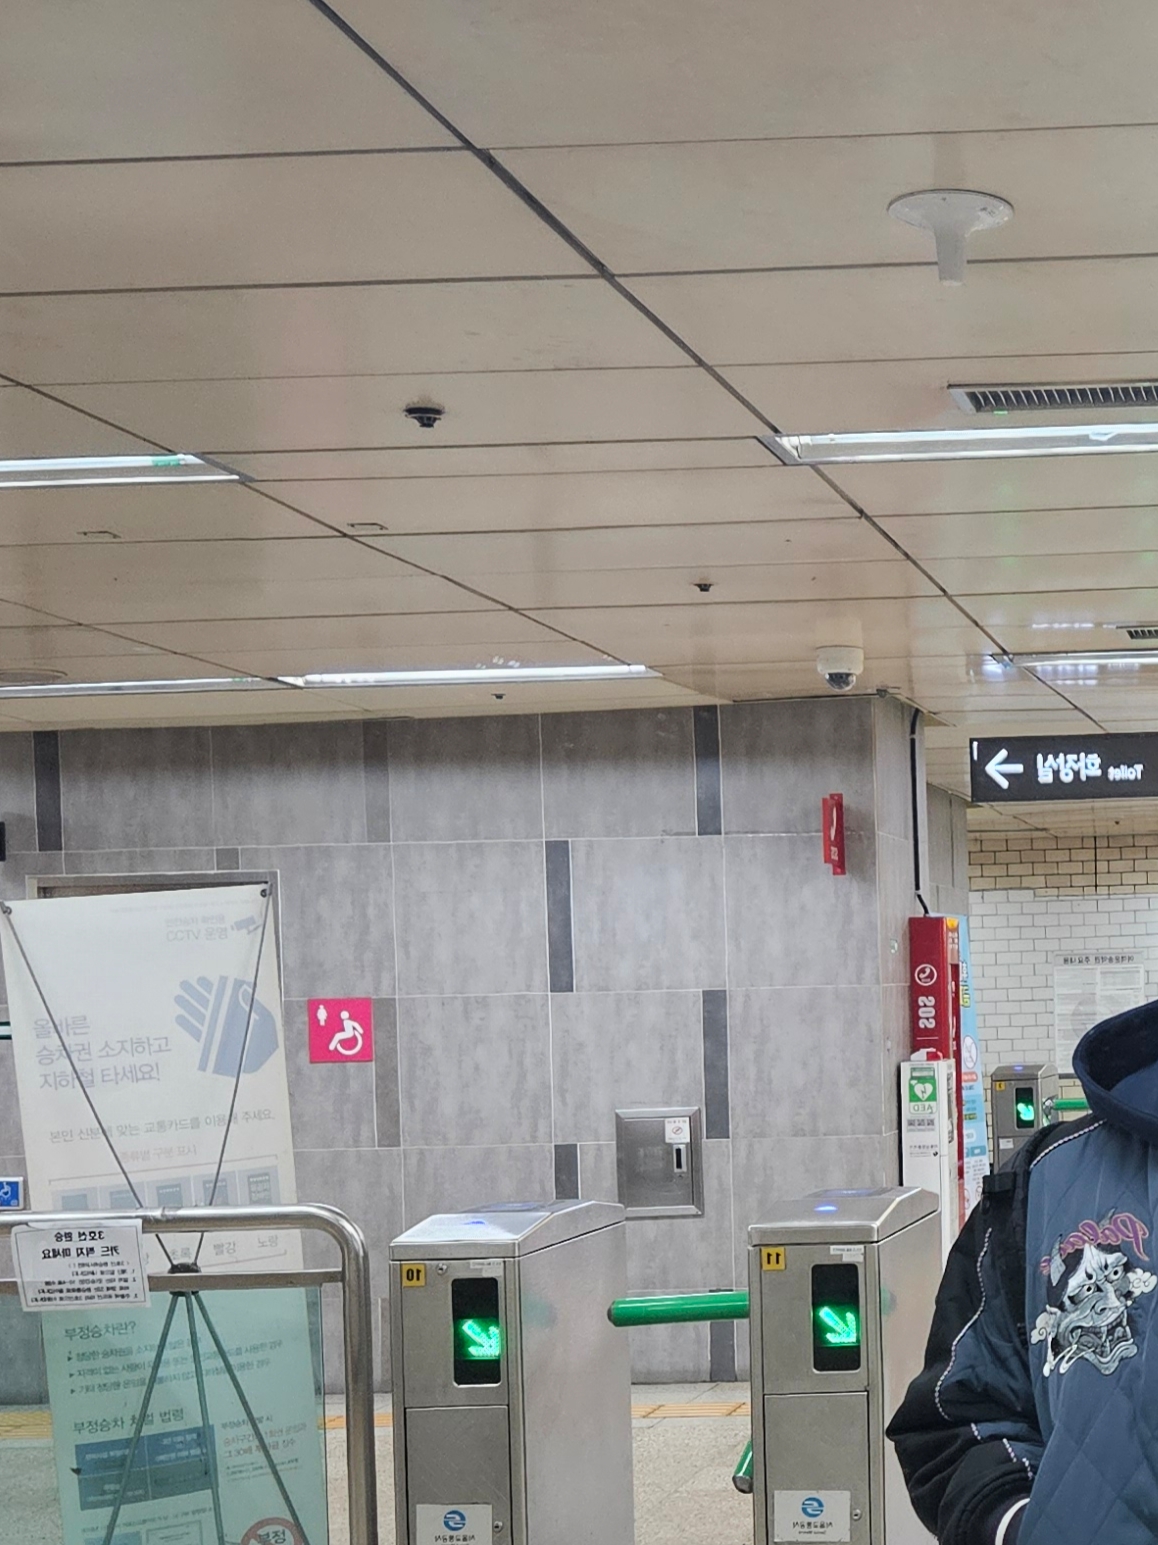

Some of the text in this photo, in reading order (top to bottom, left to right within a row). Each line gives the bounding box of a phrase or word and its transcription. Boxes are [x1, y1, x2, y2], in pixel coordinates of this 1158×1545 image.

[165, 925, 228, 942] CCTV 운영
[98, 1035, 172, 1058] 소지하고
[101, 1062, 161, 1085] 타세요!
[143, 1117, 201, 1134] 교통카드를
[64, 1320, 137, 1341] 부정승차란?
[73, 1416, 125, 1435] 부정승차
